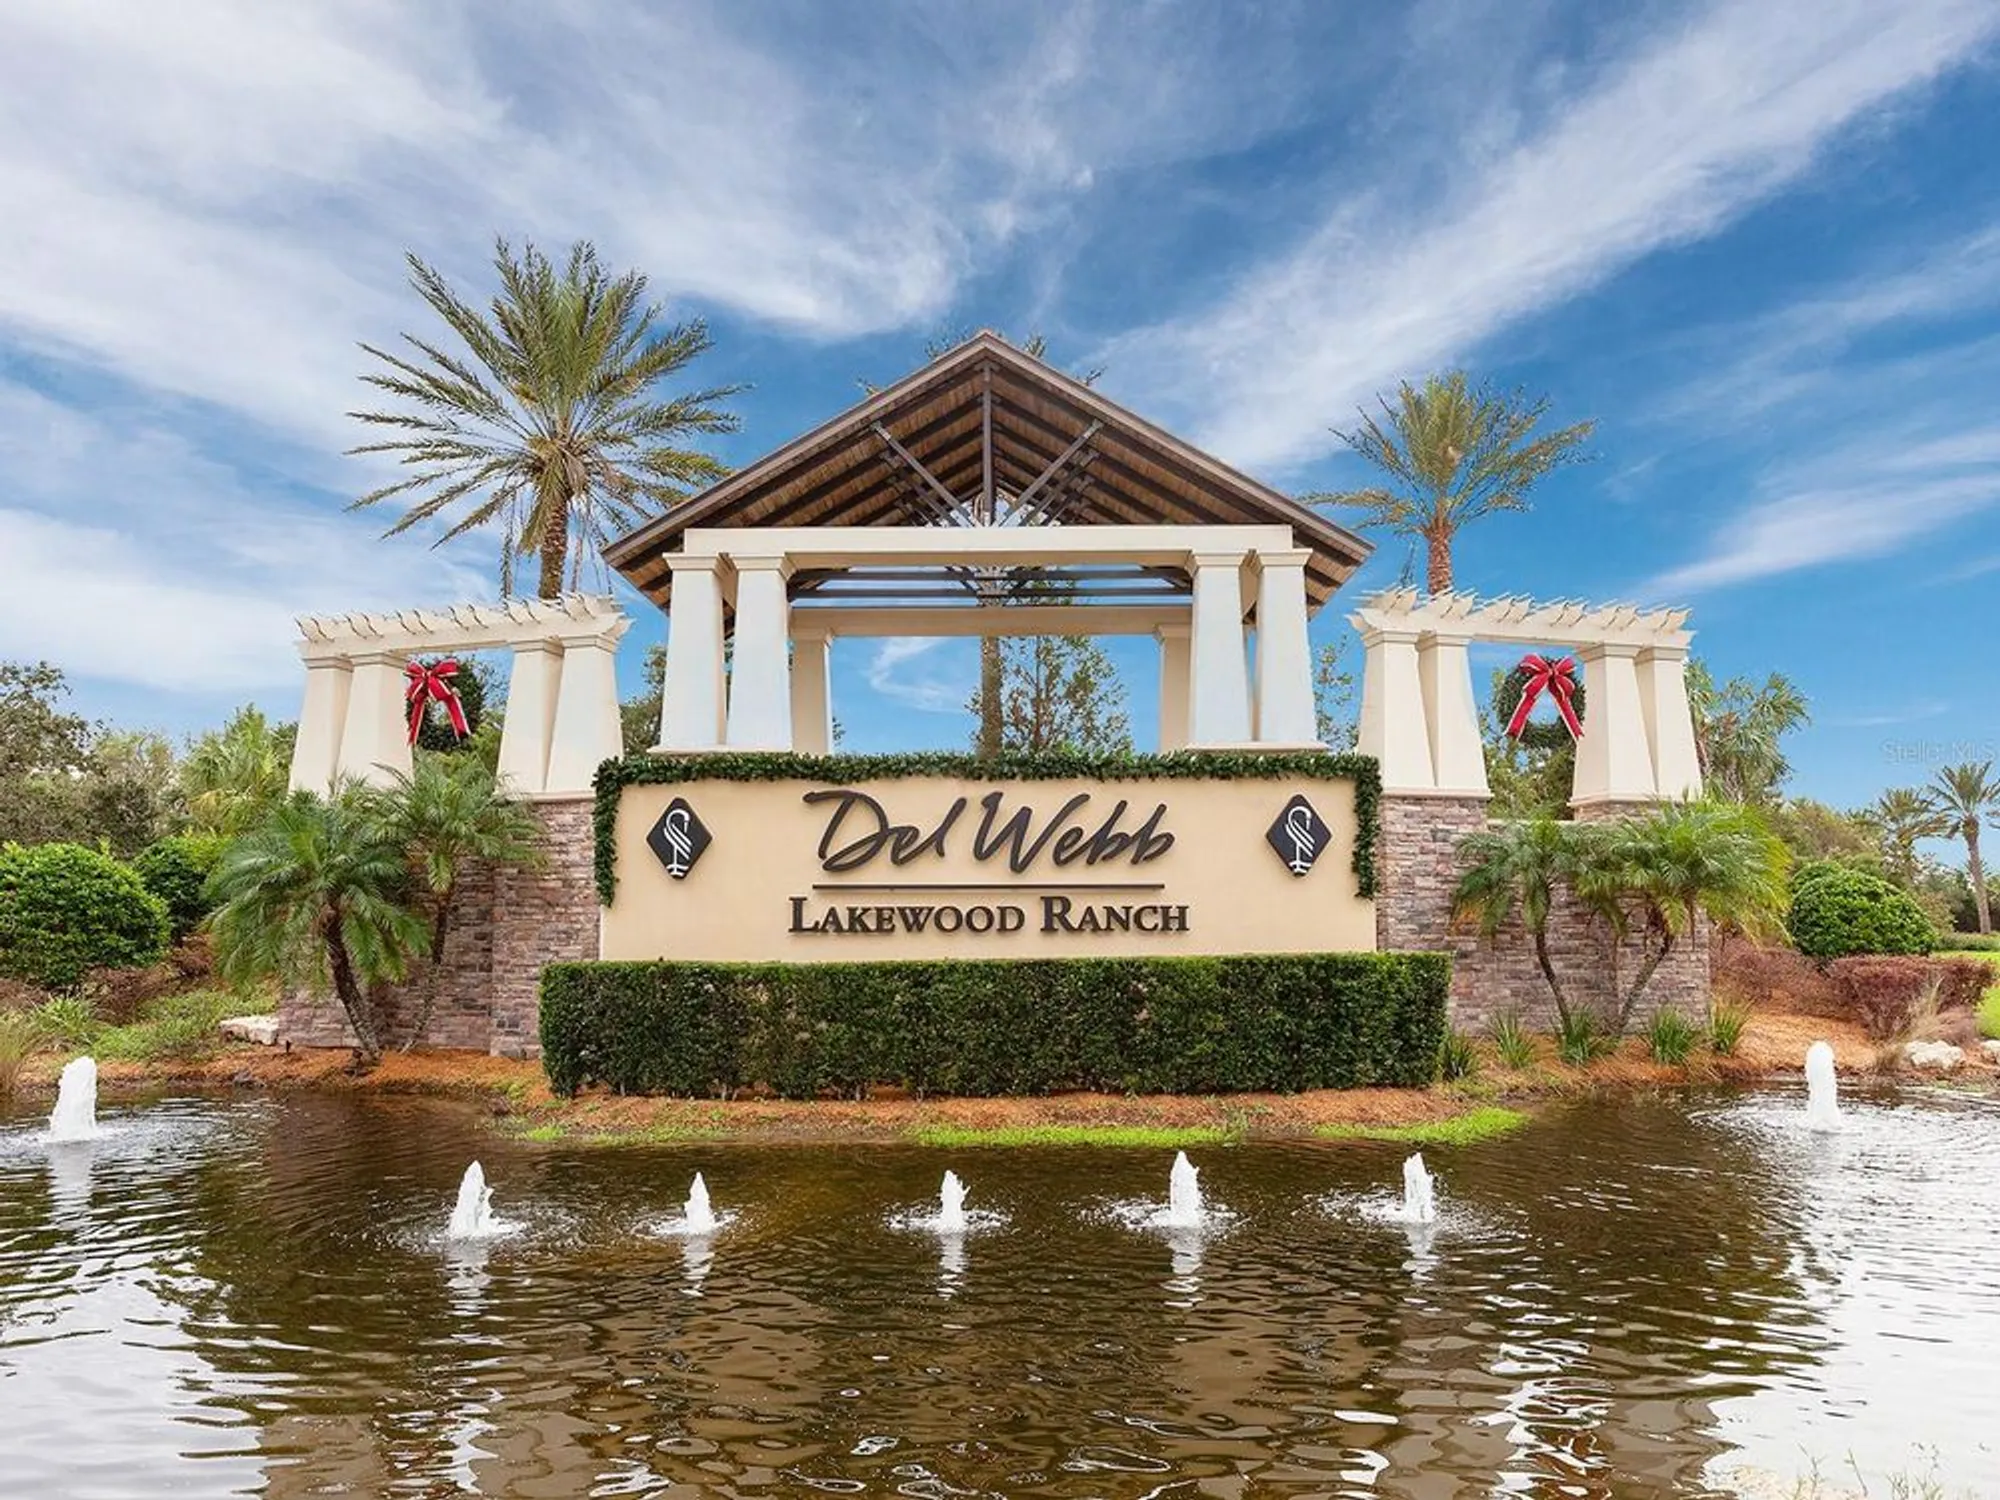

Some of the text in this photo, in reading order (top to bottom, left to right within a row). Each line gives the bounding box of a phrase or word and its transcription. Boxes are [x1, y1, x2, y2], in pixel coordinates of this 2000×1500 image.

[803, 789, 1176, 874] Del Webb
[788, 895, 1190, 935] LAKEWOOD RANCH
